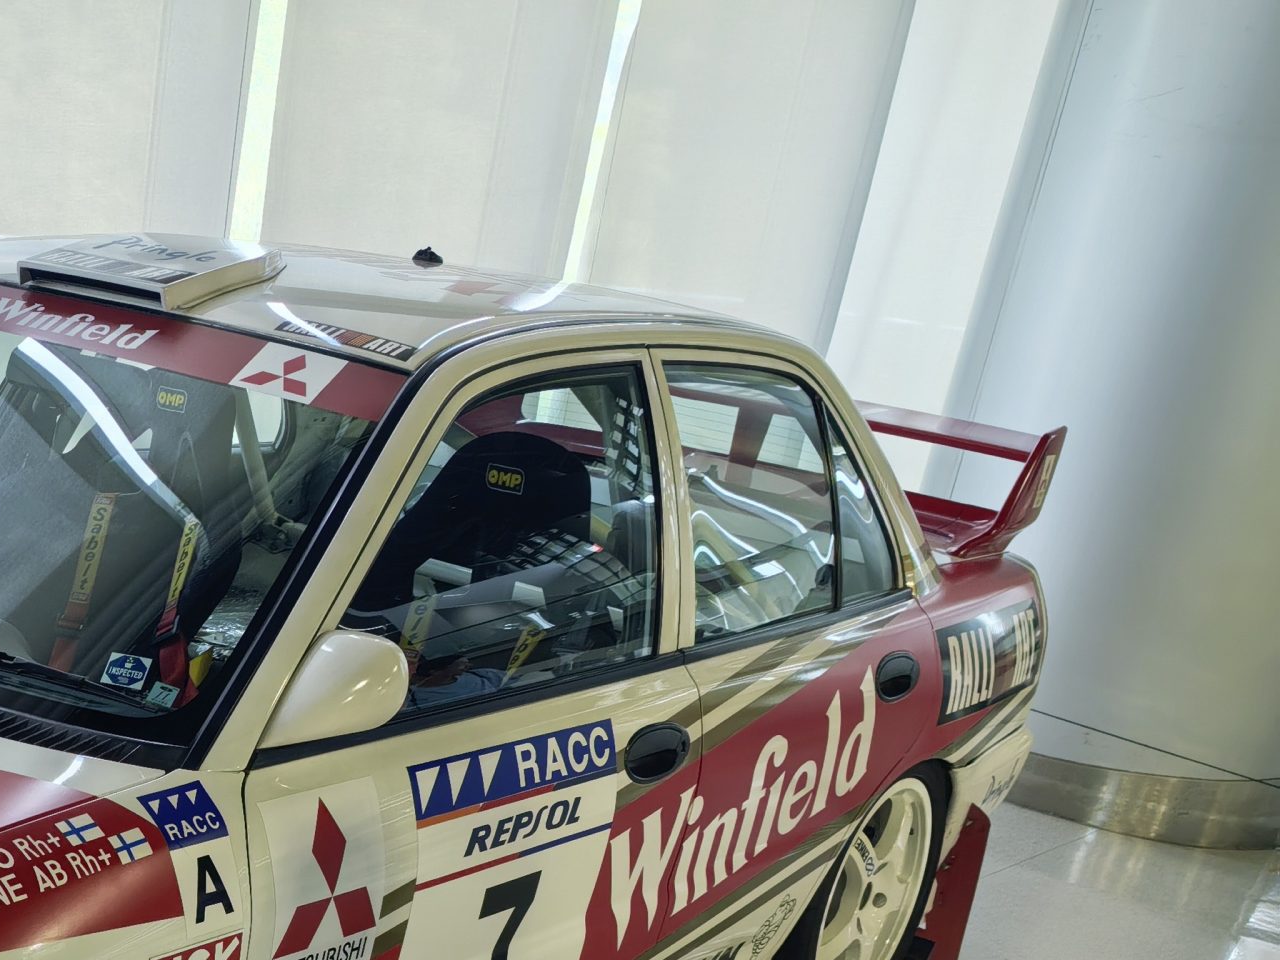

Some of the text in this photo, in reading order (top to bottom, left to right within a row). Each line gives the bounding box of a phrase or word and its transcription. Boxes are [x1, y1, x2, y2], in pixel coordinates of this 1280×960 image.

[362, 338, 413, 357] ART
[158, 390, 185, 408] OMP
[488, 469, 523, 488] OMP
[108, 665, 144, 680] INSPECTED
[945, 623, 996, 716] RALLI
[514, 726, 610, 787] RACC
[165, 811, 221, 842] RACC
[464, 796, 582, 858] REPSOL
[609, 664, 877, 951] Winfield
[15, 831, 62, 862] Rh+
[33, 858, 69, 894] AB
[69, 847, 113, 880] Rh+
[194, 854, 235, 925] A
